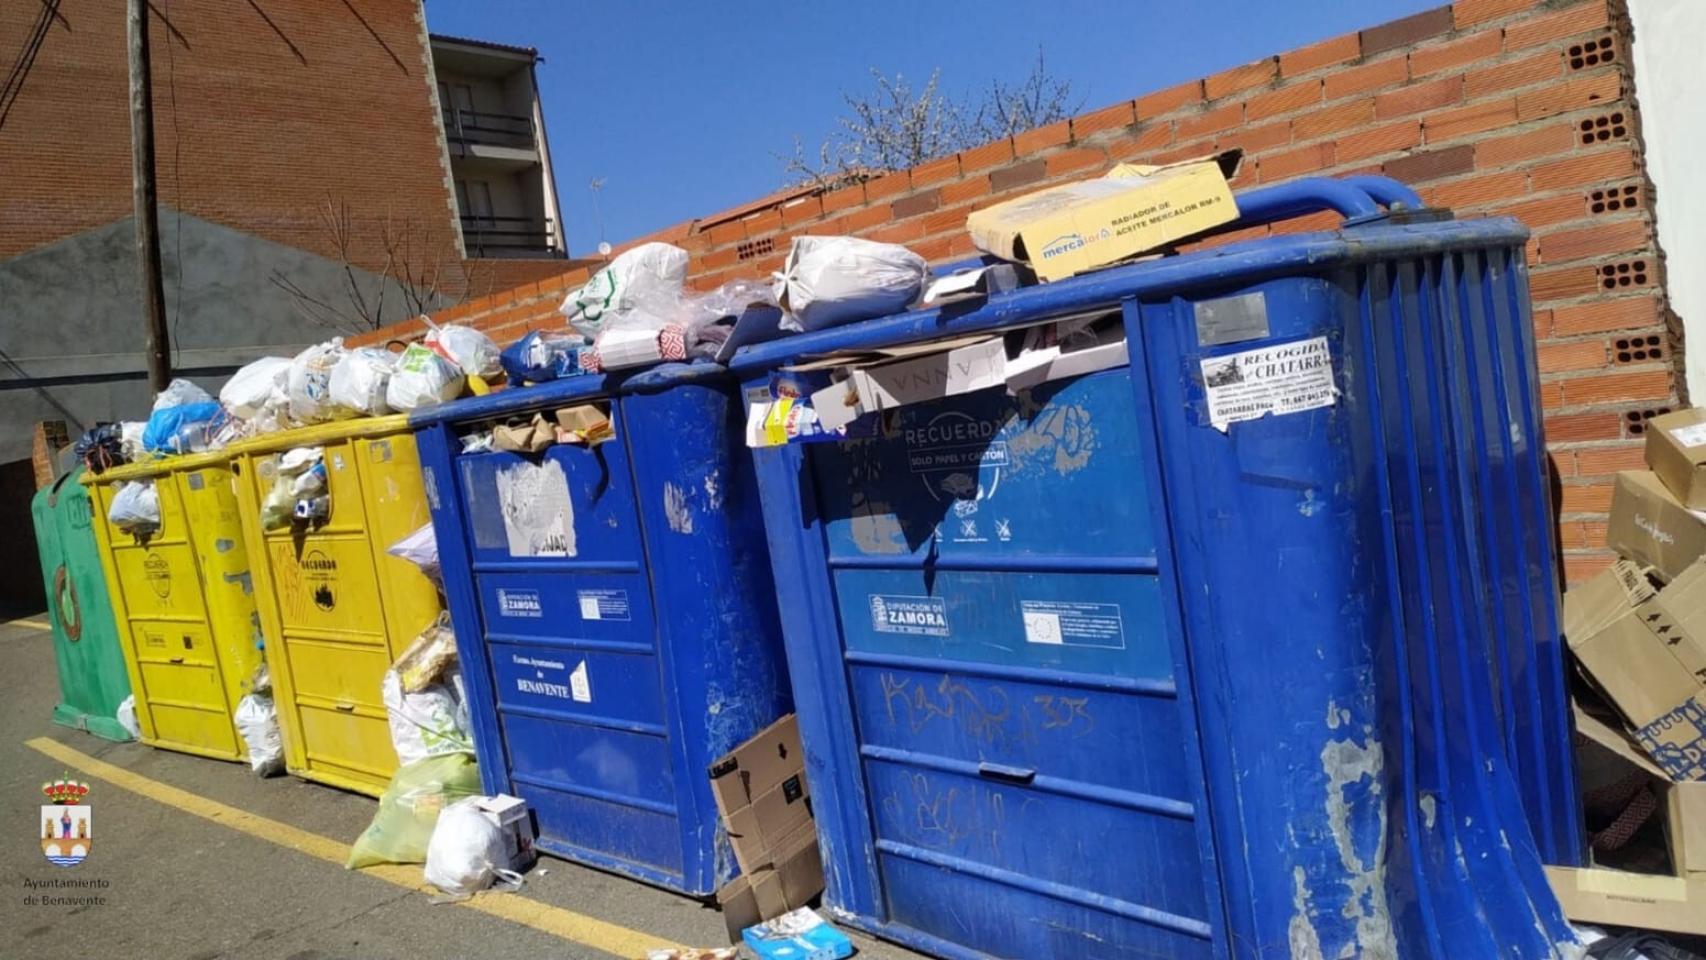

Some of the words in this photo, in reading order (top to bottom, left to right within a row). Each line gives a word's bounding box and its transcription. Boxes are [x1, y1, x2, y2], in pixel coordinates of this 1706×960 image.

[1111, 206, 1157, 226] RADIADOR
[1159, 202, 1171, 211] DE
[1116, 221, 1147, 237] ACEITE
[1149, 204, 1198, 225] MERCALOR
[1043, 234, 1099, 259] mercalor
[508, 600, 541, 610] ZAMORA
[888, 611, 945, 627] ZAMORA
[516, 678, 570, 699] BENAVENTE
